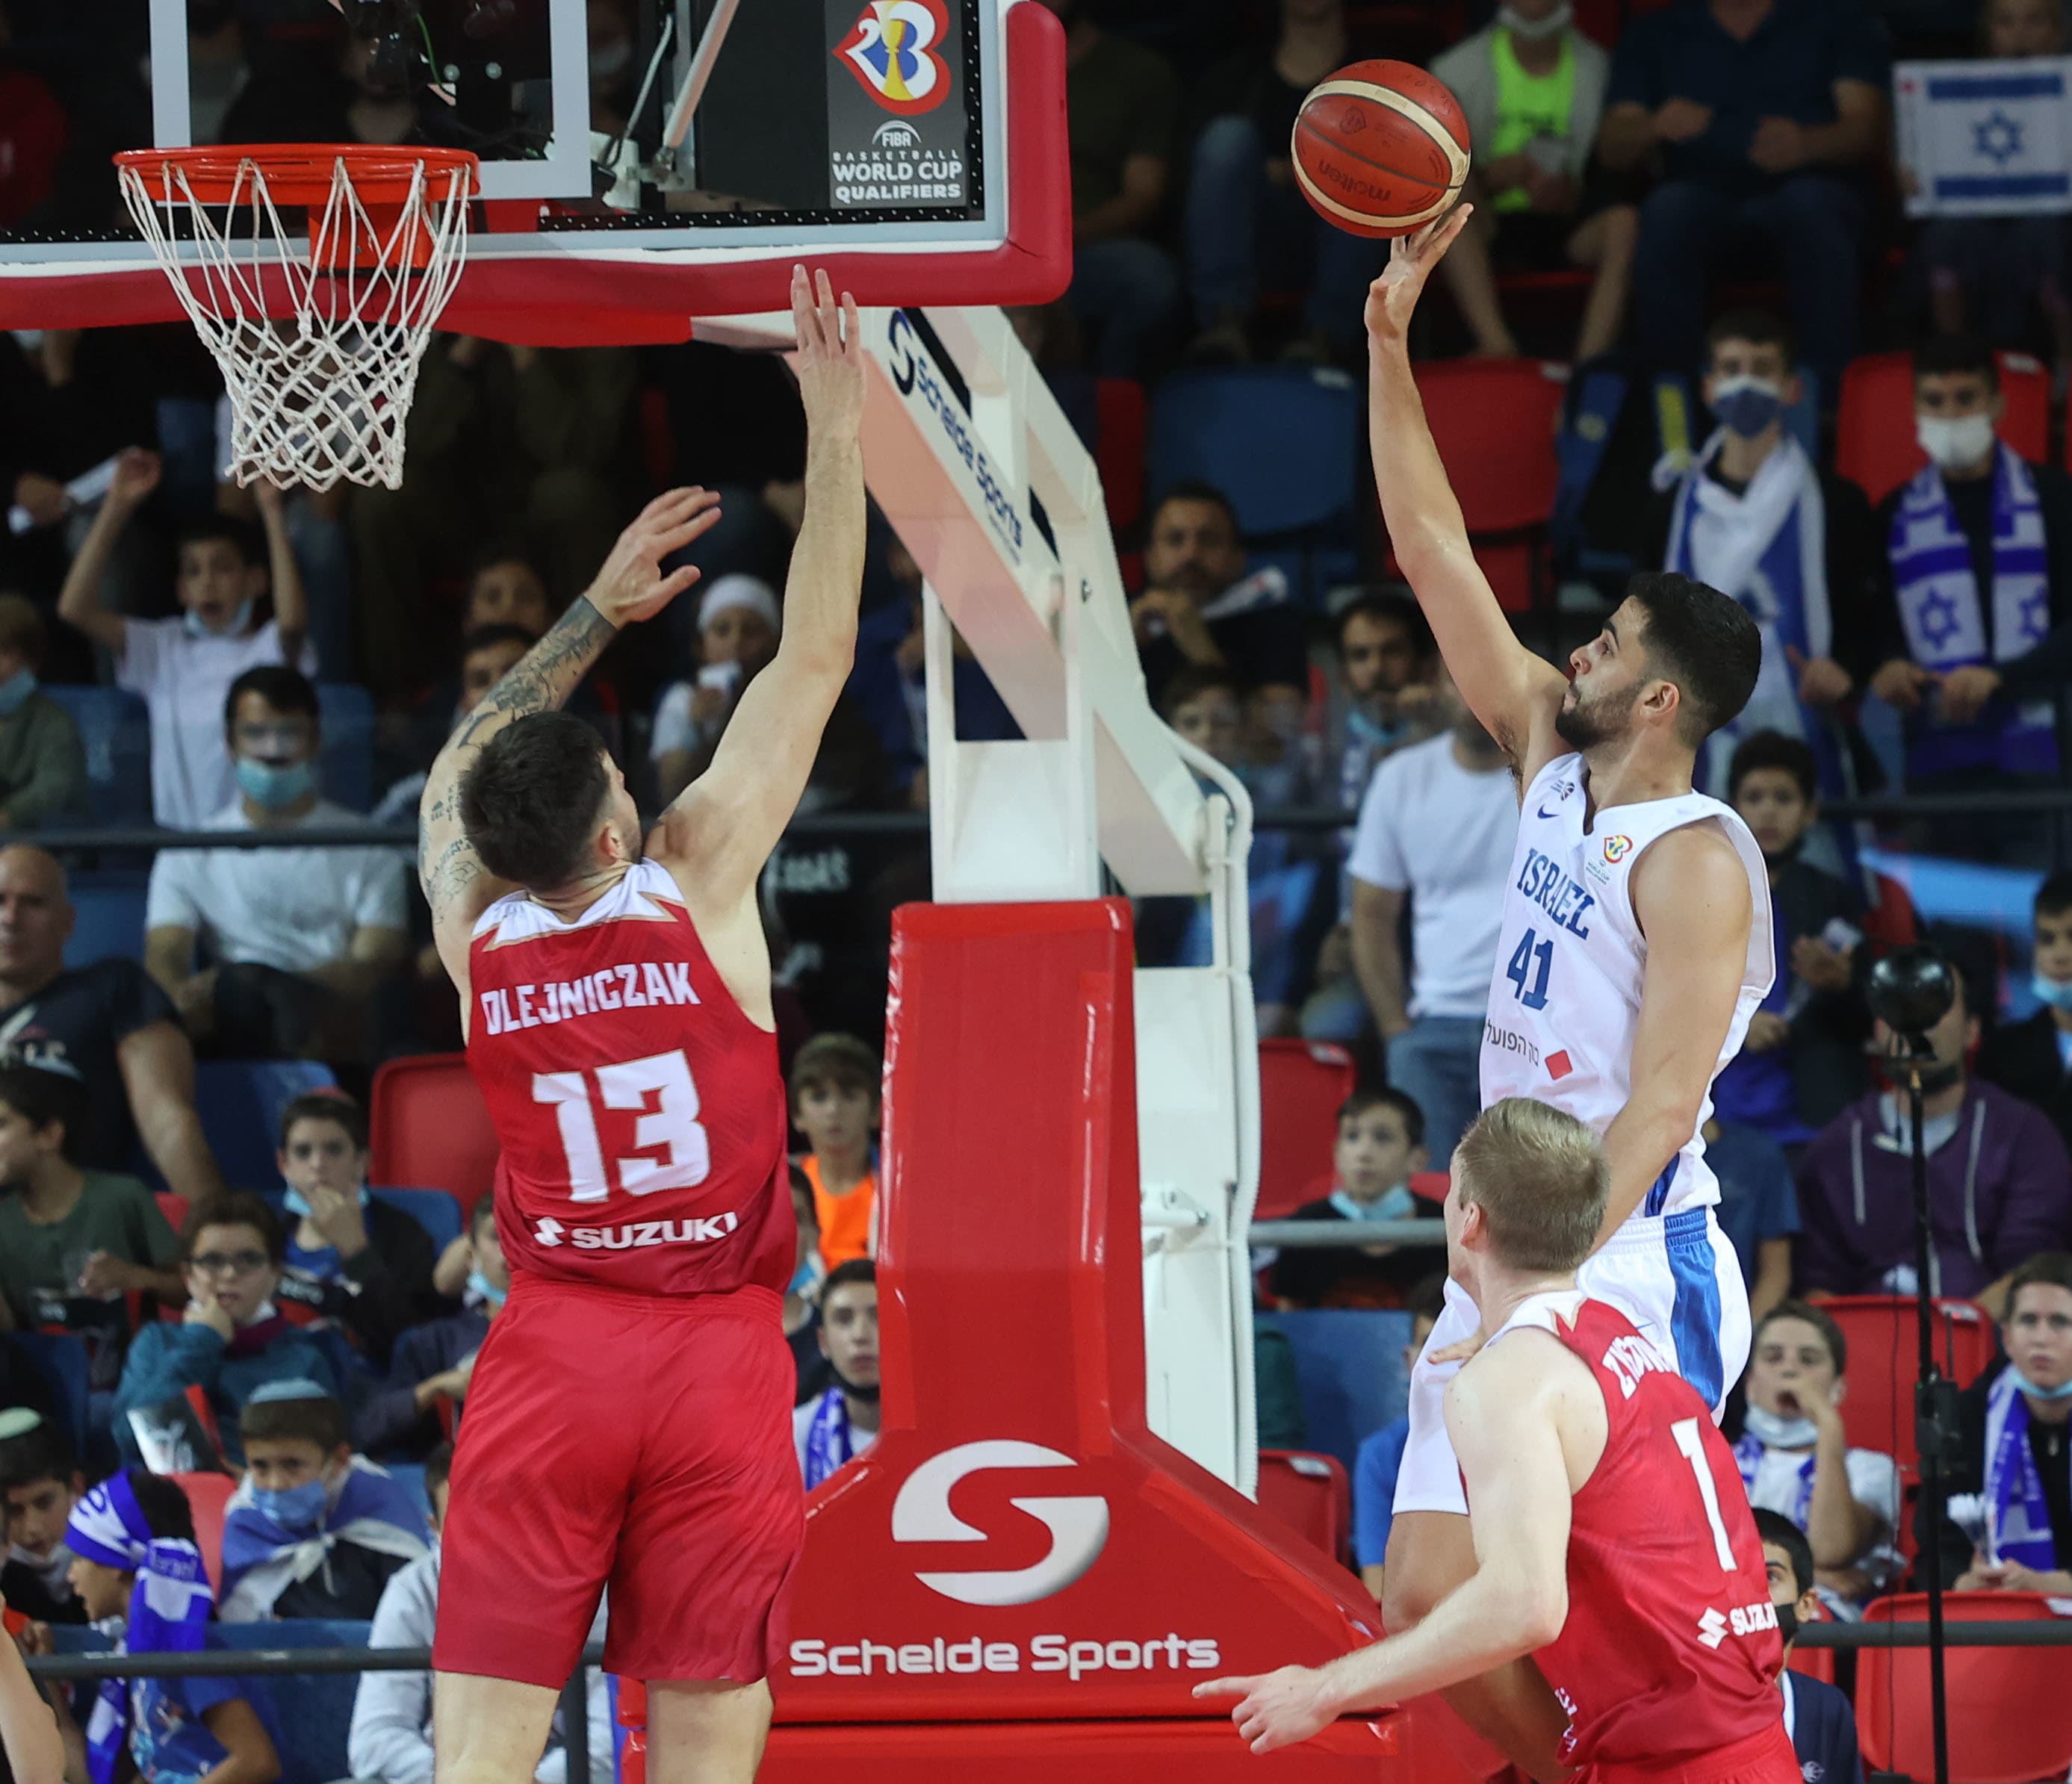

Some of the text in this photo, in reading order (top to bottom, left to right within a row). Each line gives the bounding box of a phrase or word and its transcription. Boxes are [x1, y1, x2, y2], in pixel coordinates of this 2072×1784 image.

[832, 149, 959, 163] BASKETBALL
[881, 131, 912, 147] FIBA
[832, 160, 963, 183] WORLD CUP
[1316, 159, 1392, 202] molten
[834, 183, 961, 204] QUALIFIERS
[1516, 847, 1595, 941] ISRAEL
[1506, 927, 1554, 1012] 41
[480, 962, 701, 1035] OLEJNICZAK
[531, 1048, 711, 1205] 13
[571, 1211, 740, 1250] SUZUKI
[1670, 1417, 1738, 1573] 1
[1728, 1601, 1779, 1637] SUZU
[790, 1632, 1220, 1682] Schelde Sports
